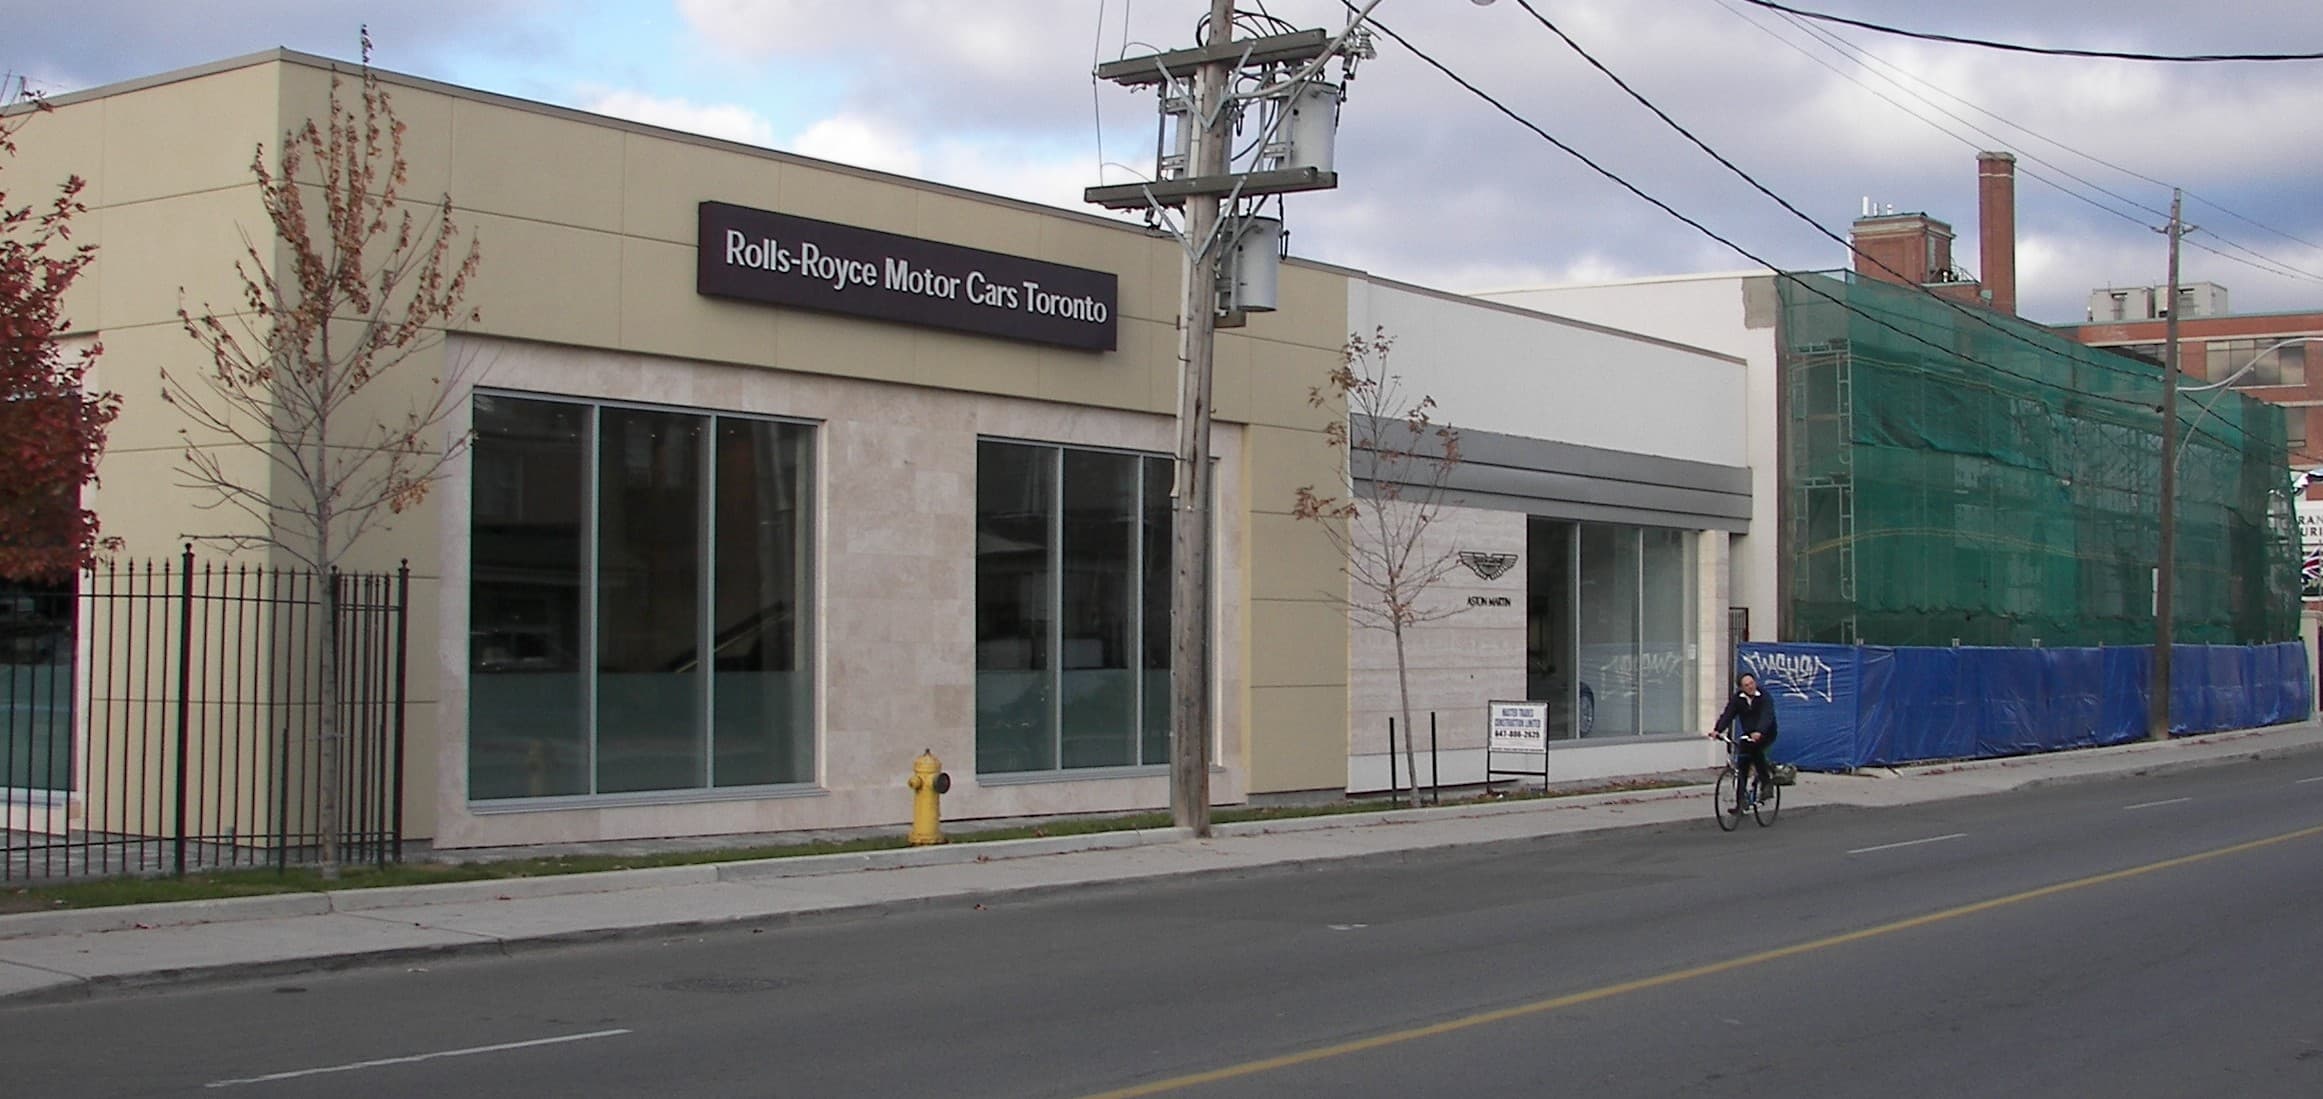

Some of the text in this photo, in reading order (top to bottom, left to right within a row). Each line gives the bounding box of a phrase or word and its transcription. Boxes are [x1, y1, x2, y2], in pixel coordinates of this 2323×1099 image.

[726, 229, 1107, 323] Rolls-Royce Motor Cars Toronto
